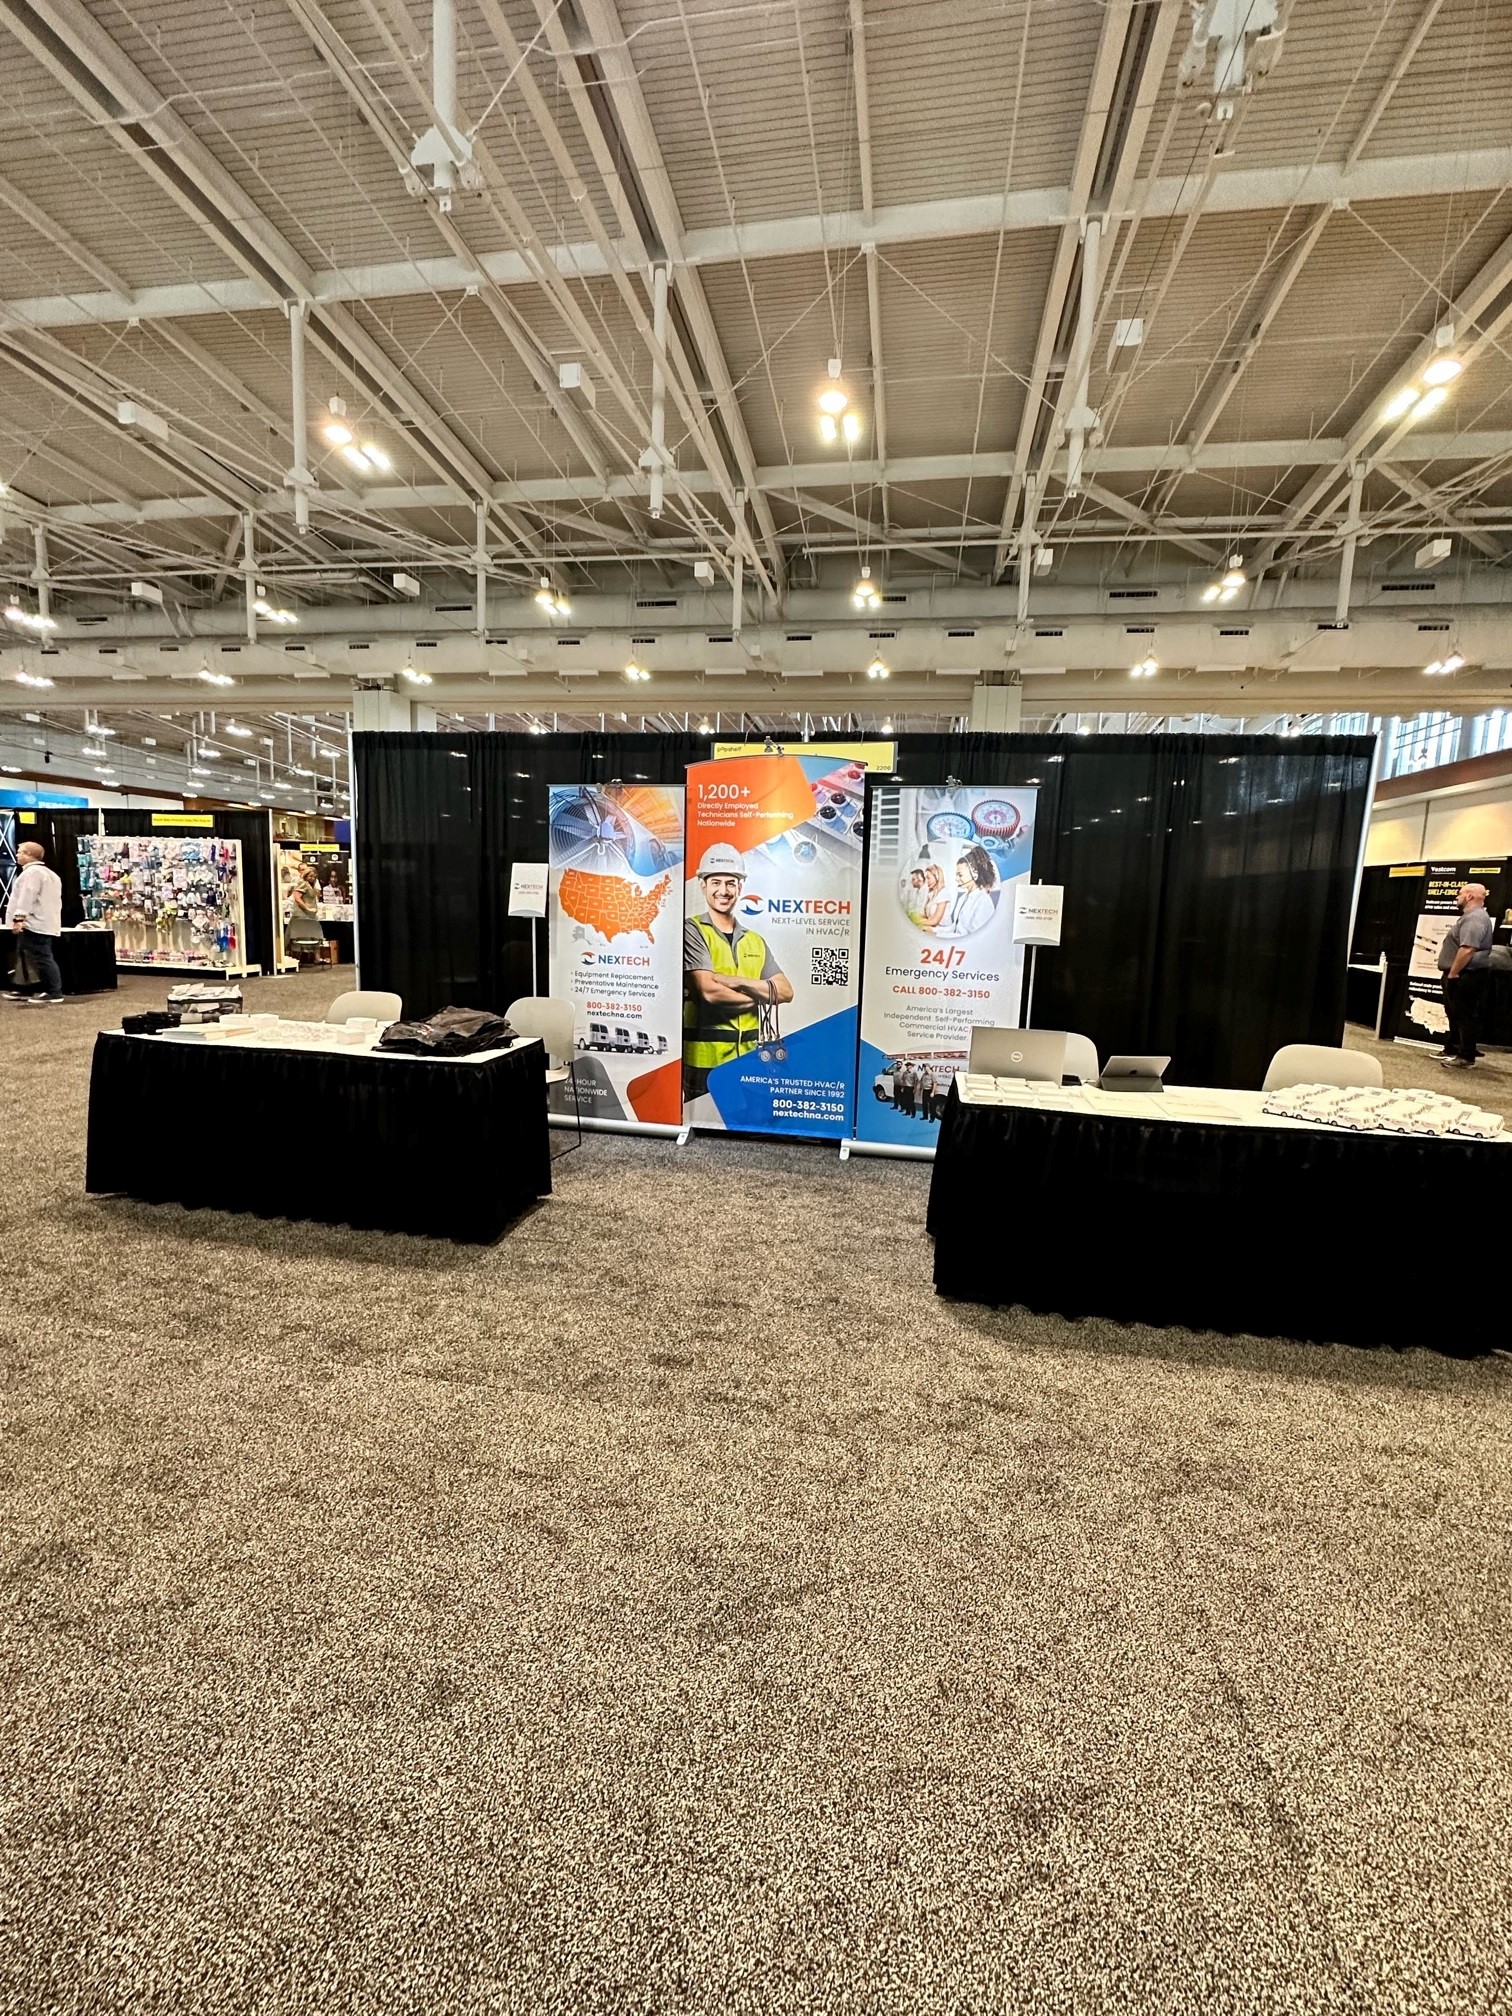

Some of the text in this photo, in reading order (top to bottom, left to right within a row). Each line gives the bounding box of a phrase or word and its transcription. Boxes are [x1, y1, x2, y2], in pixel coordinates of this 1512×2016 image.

[698, 784, 750, 800] 1,200+
[697, 802, 759, 811] Directly Employed
[739, 812, 794, 820] Self-Performing
[768, 899, 850, 914] NEXTECH
[772, 917, 815, 926] NEXT-LEVEL
[816, 928, 850, 937] HVAC/R
[598, 955, 650, 966] NEXTECH
[921, 946, 966, 968] 24/7
[611, 973, 654, 981] Replacement
[885, 966, 1000, 982] Emergency Services
[591, 988, 627, 997] Emergency
[893, 985, 990, 999] CALL 800-382-3150
[587, 1001, 642, 1012] 800-382-3150
[906, 1005, 973, 1016] America's Largest
[884, 1012, 995, 1026] Independent Self-Performing
[899, 1022, 946, 1031] Commercial
[936, 1033, 969, 1041] Provider.
[740, 1076, 845, 1090] AMERICA'S TRUSTED HVAC/R
[770, 1087, 802, 1095] PARTNER
[772, 1099, 844, 1112] 800-382-3150
[773, 1110, 844, 1121] nextechna.com
